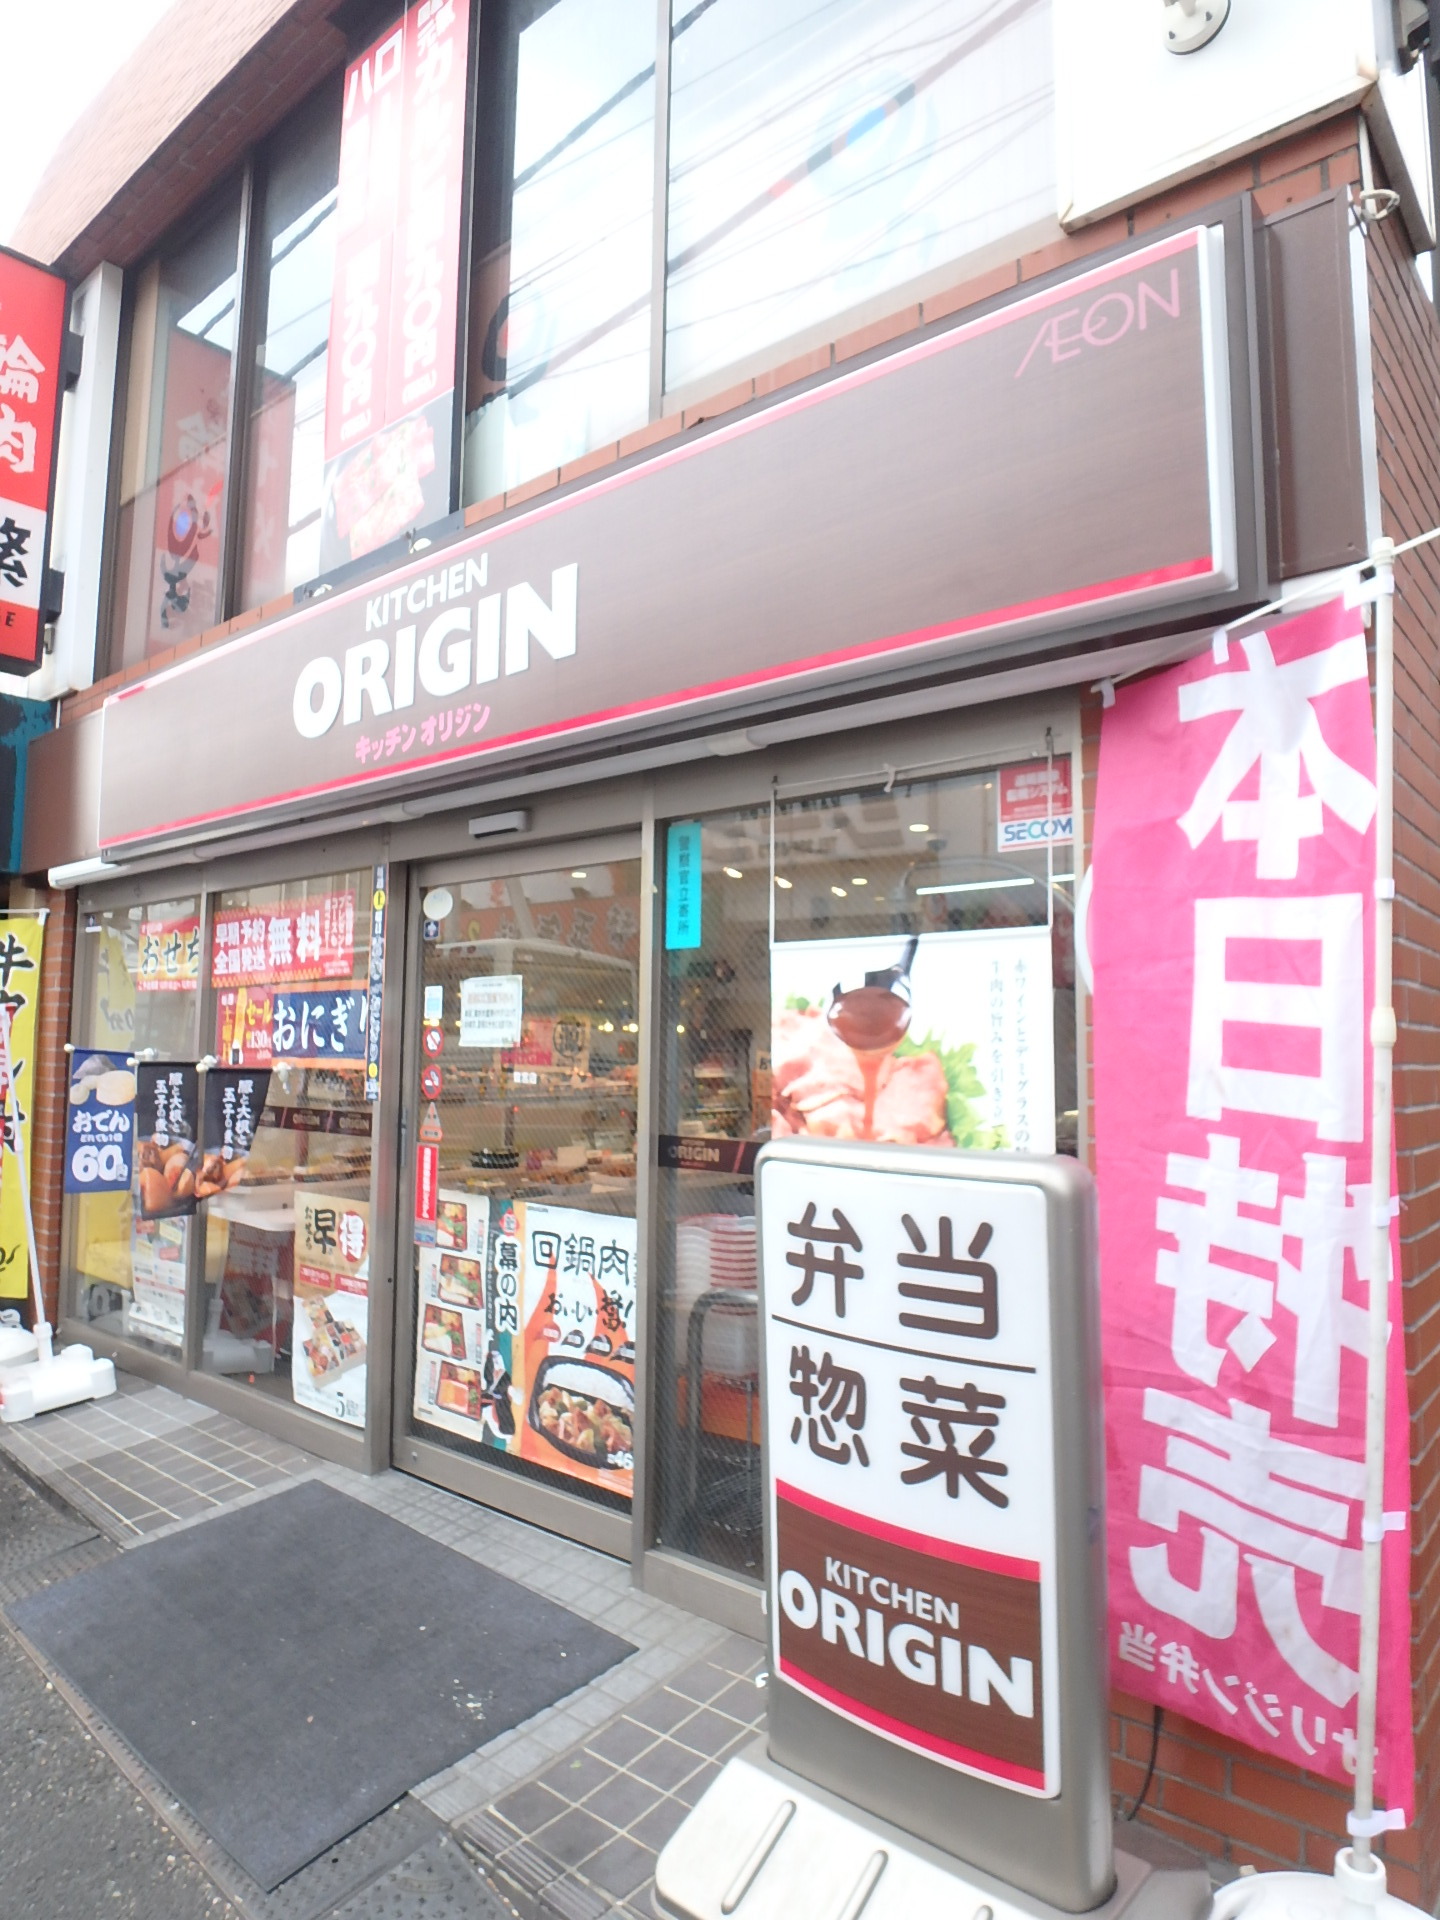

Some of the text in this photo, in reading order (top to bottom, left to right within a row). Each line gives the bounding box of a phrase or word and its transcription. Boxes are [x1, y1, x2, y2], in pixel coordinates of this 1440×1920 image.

[365, 553, 489, 632] KITCHEN
[292, 562, 579, 739] ORIGIN
[355, 702, 491, 765] キッチン オリジン
[1004, 817, 1073, 842] SECOM
[268, 910, 322, 967] 無料
[246, 998, 274, 1026] セール
[1014, 957, 1031, 1153] 赤ワインとデミグラスの
[72, 1109, 131, 1133] おでん
[668, 1145, 720, 1162] ORIGIN
[499, 1241, 518, 1332] 幕の内
[531, 1231, 630, 1286] 回鍋肉
[786, 1200, 999, 1341] 弁当
[788, 1344, 1011, 1510] 惣菜
[824, 1556, 960, 1631] KITCHEN
[778, 1569, 1035, 1720] ORIGIN
